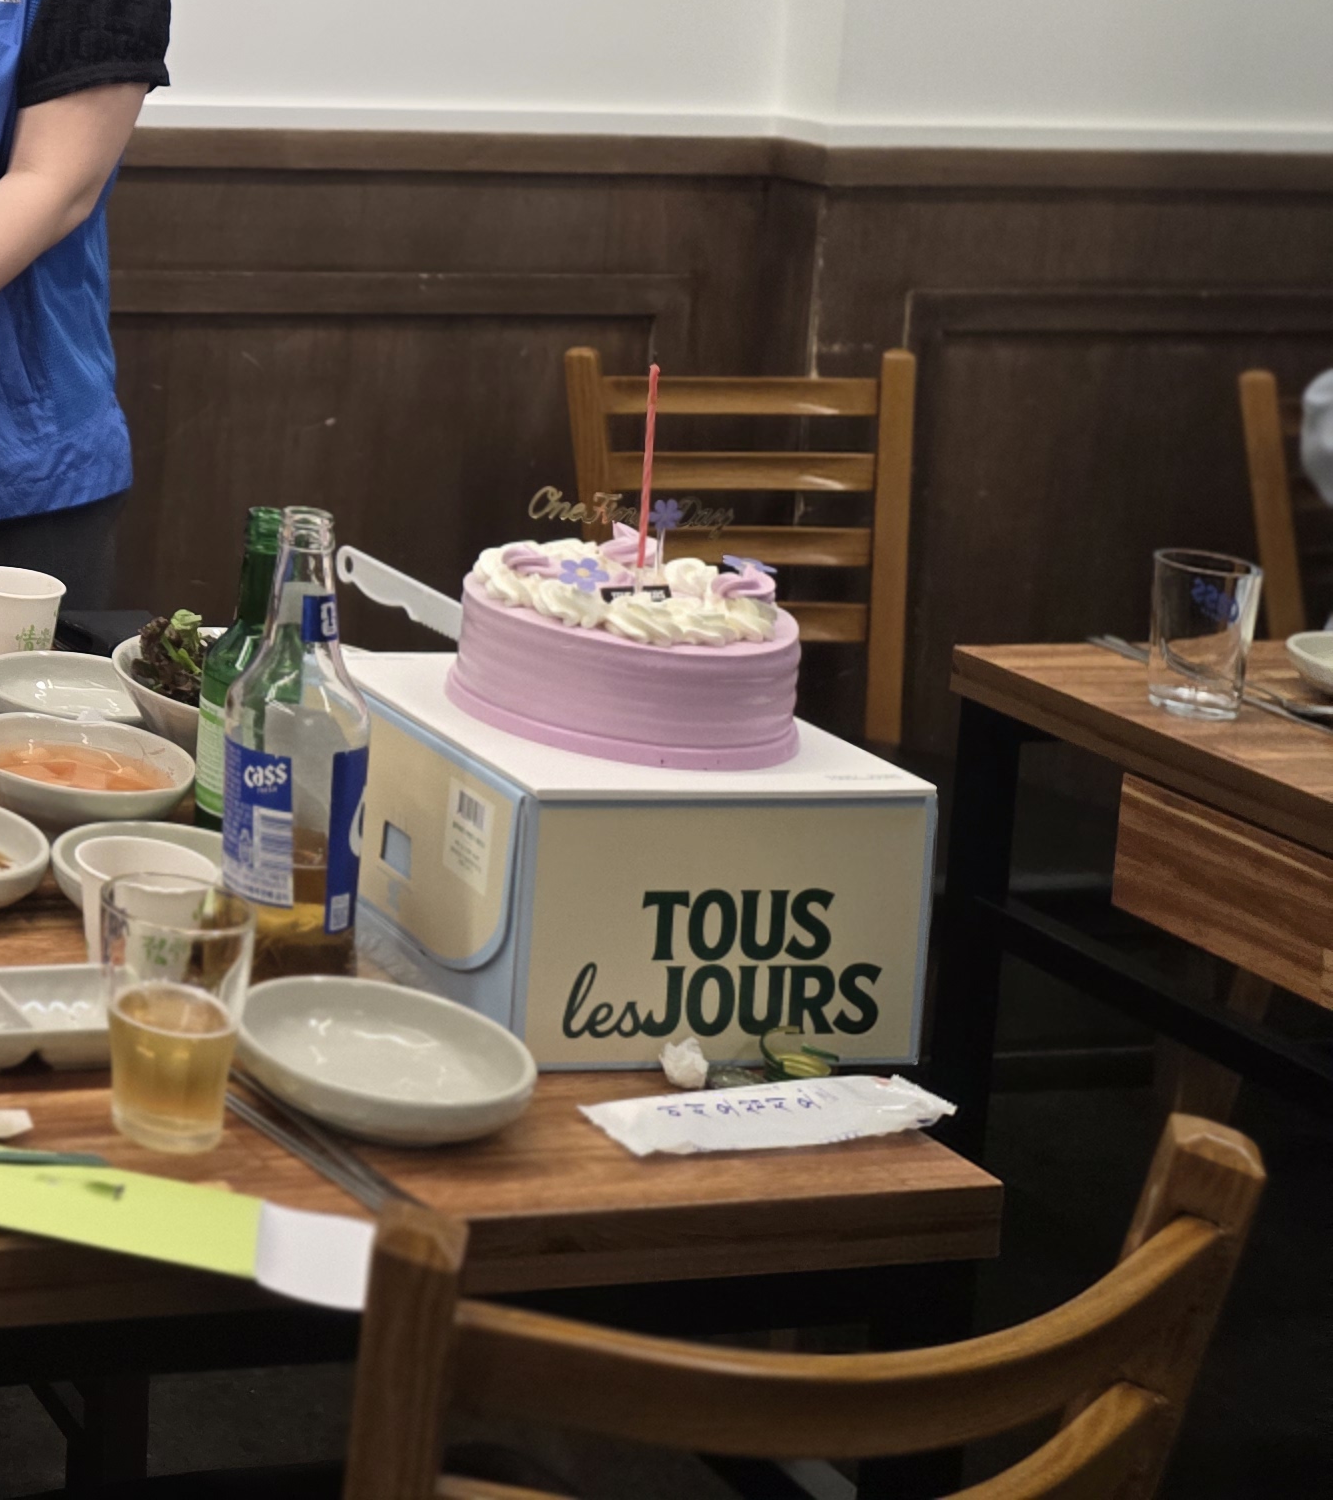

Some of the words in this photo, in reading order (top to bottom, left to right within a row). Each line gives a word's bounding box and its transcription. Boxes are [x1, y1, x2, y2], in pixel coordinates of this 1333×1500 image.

[528, 486, 587, 524] One
[584, 492, 641, 524] Fin
[643, 889, 835, 961] TOUS
[563, 963, 639, 1038] les
[636, 963, 882, 1037] JOURS
